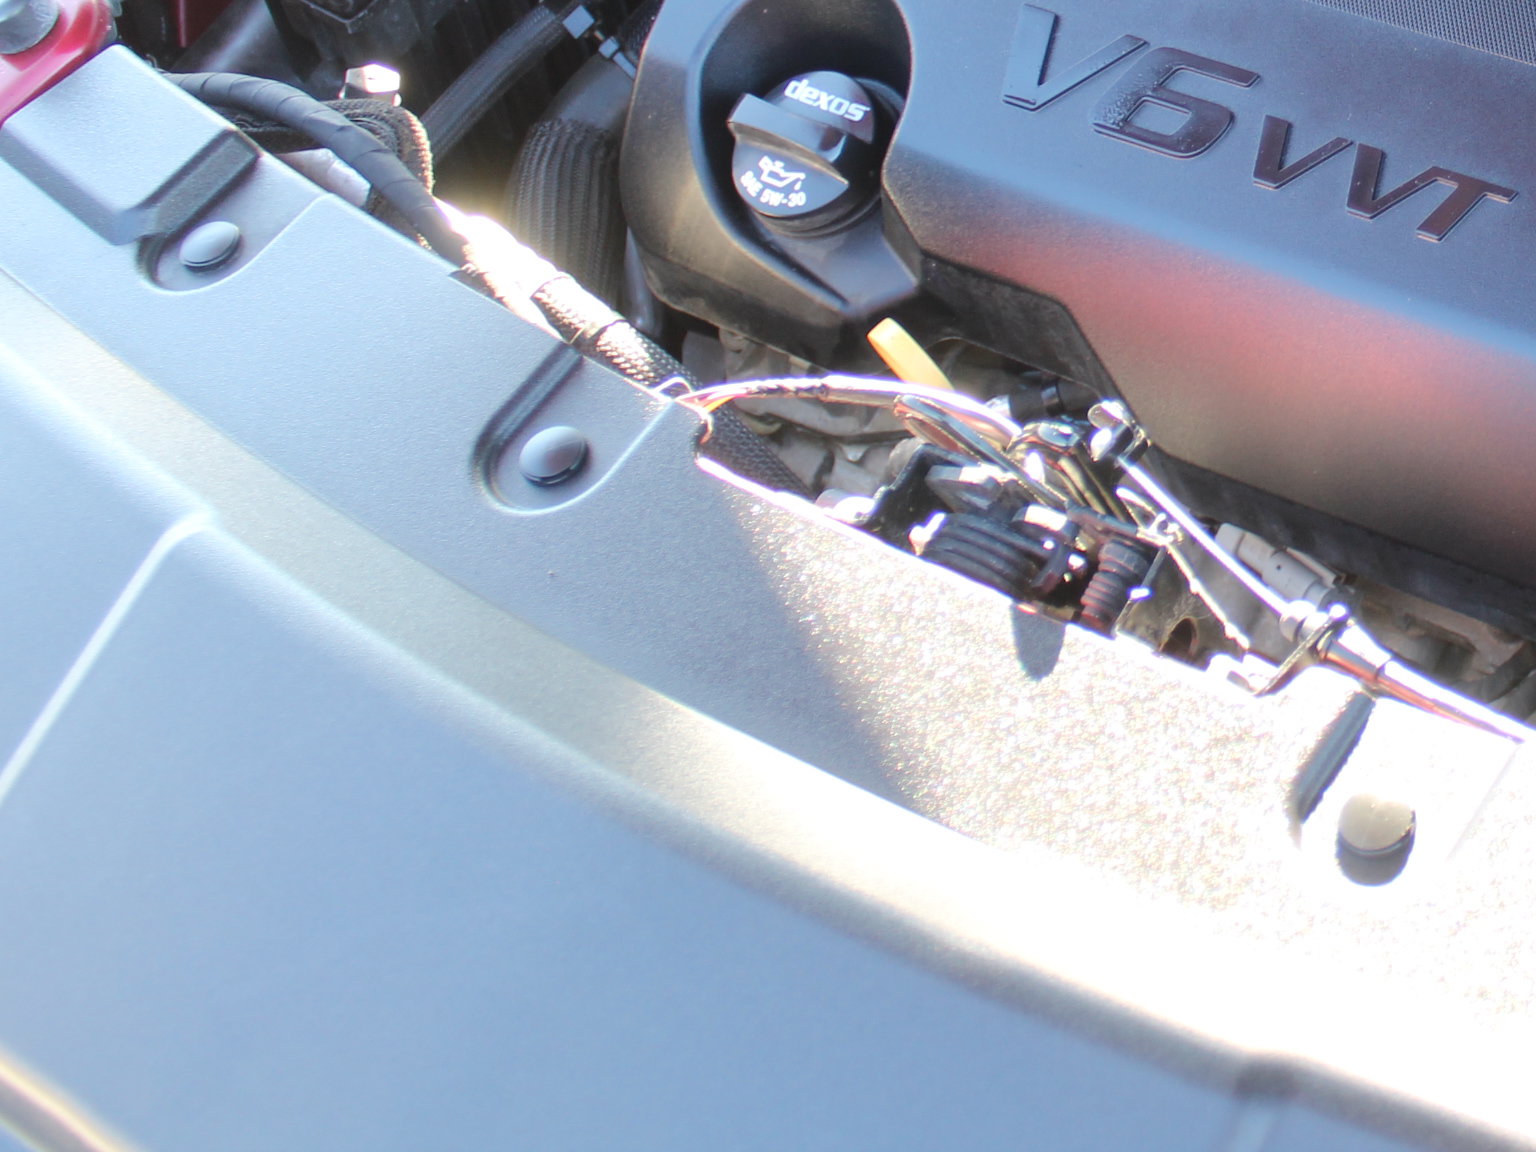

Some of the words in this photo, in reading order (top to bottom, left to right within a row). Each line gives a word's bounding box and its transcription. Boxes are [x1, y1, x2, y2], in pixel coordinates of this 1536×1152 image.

[784, 78, 870, 122] dexos
[1002, 3, 1260, 160] V6
[1252, 114, 1518, 243] VVT
[740, 170, 763, 197] SAE
[760, 188, 806, 207] 5W-30
